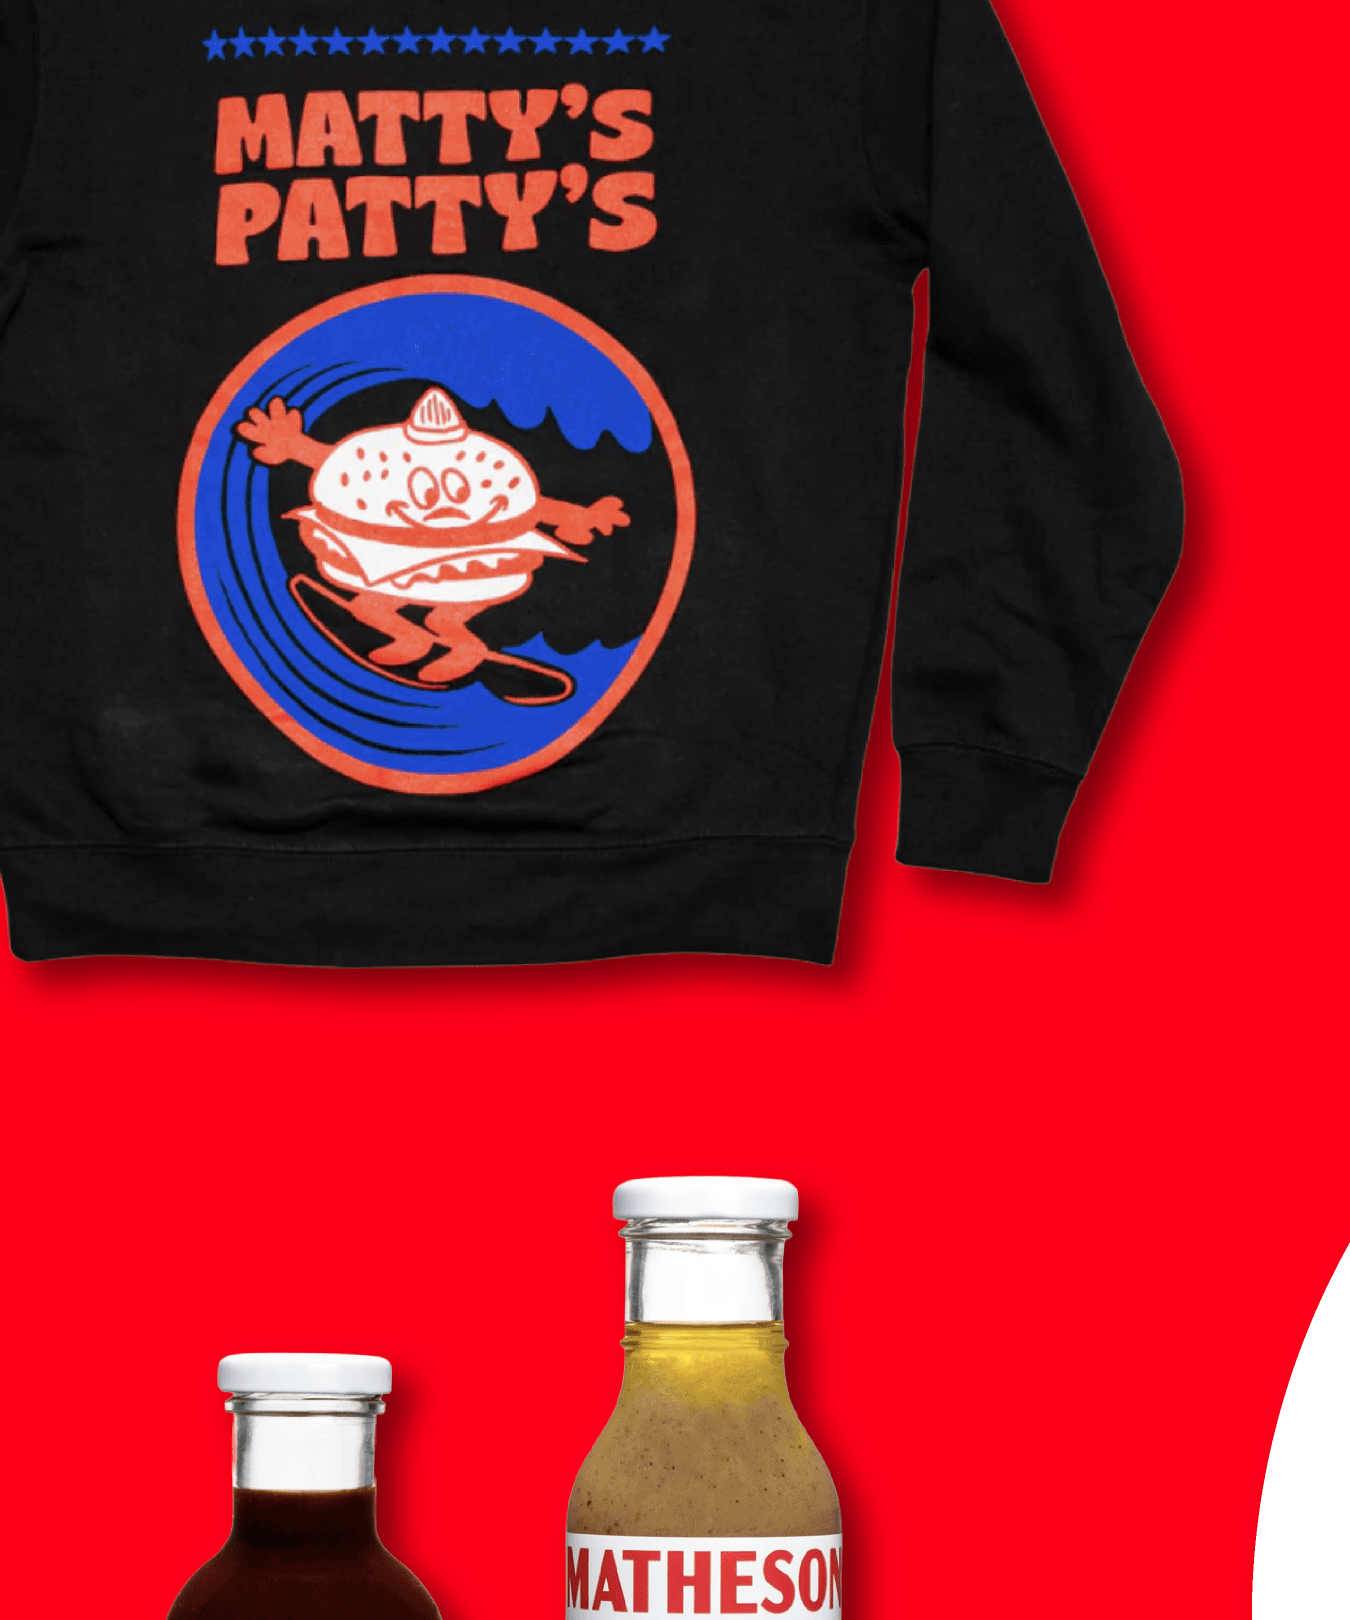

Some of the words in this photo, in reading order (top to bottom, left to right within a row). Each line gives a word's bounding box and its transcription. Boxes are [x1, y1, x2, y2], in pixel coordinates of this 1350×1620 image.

[214, 83, 655, 176] MATTY'S
[214, 163, 658, 267] PATTY'S
[566, 1546, 841, 1614] MATHESON
